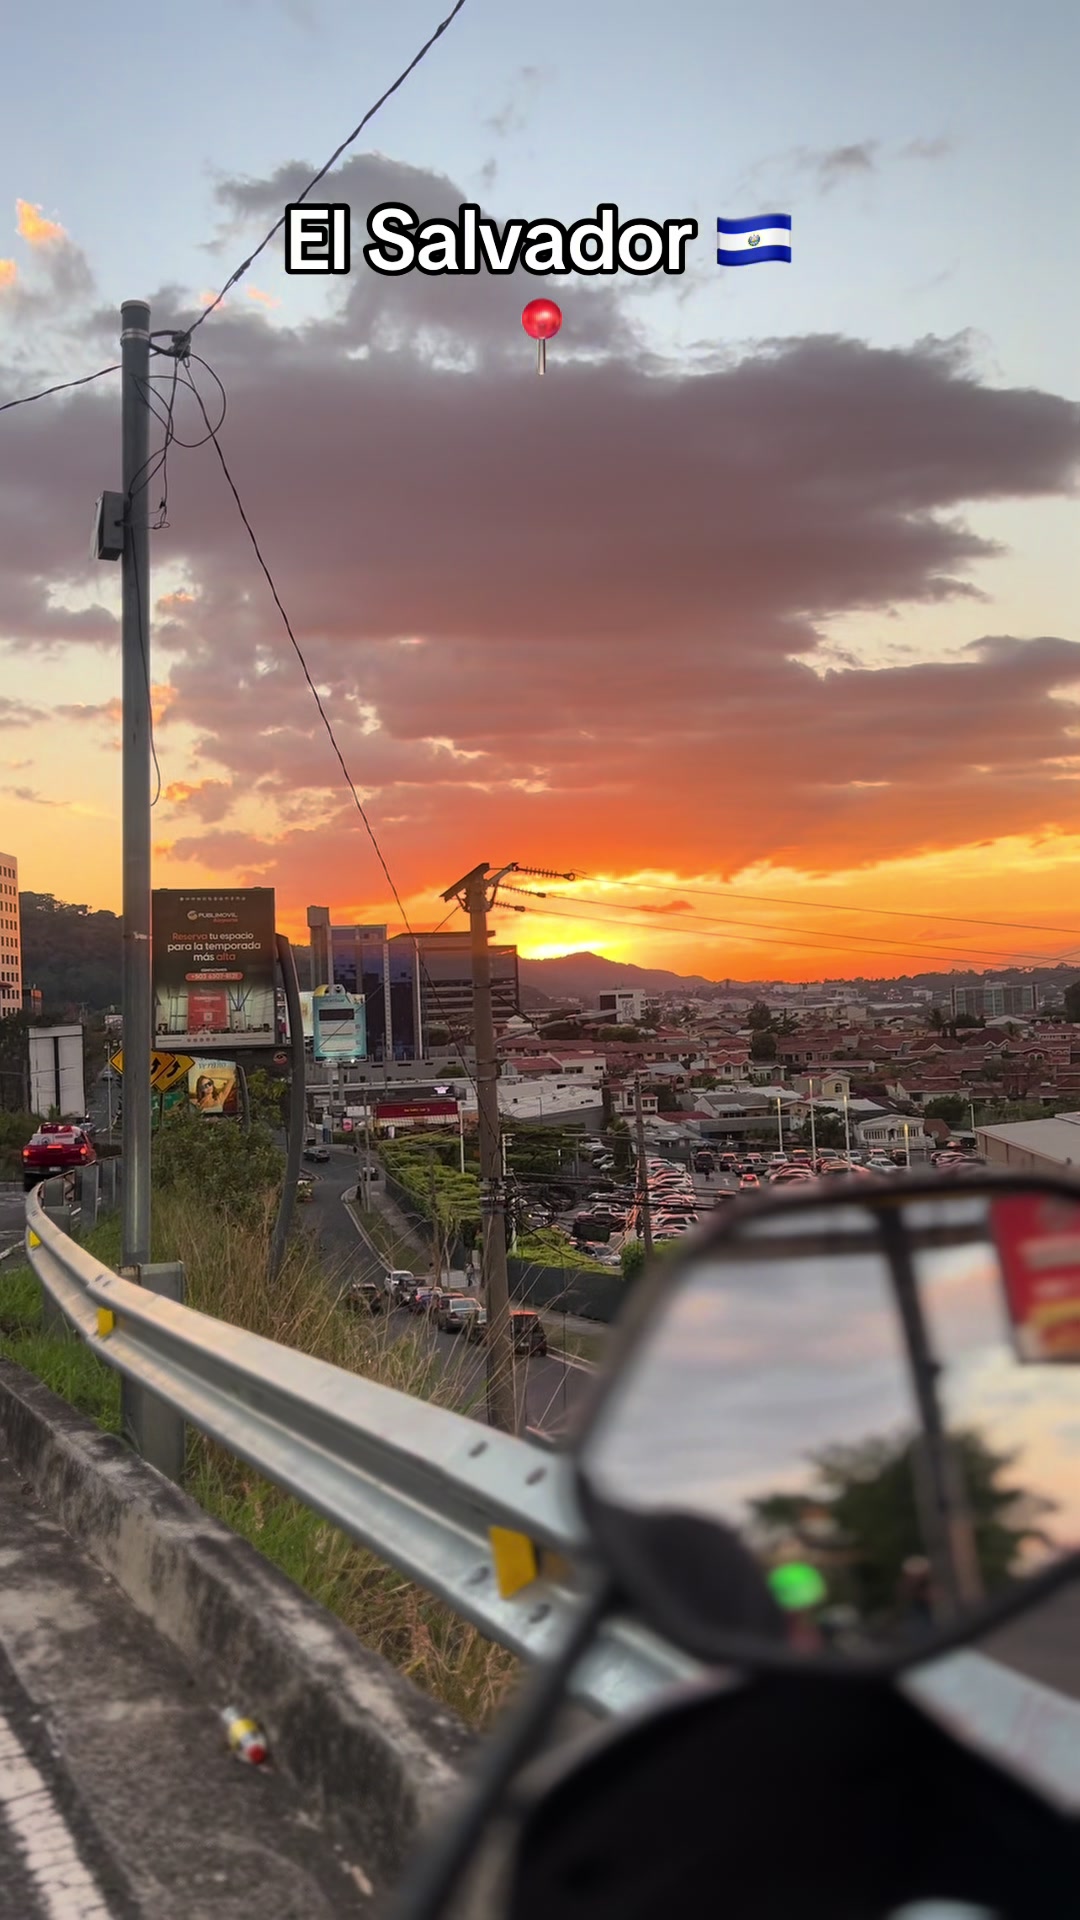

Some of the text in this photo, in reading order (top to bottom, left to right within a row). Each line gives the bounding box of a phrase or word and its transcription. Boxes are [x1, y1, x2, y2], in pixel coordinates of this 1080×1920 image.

[172, 932, 208, 940] Reserva
[219, 931, 254, 941] espacio
[167, 941, 261, 952] para la temporada
[193, 952, 236, 961] más alta
